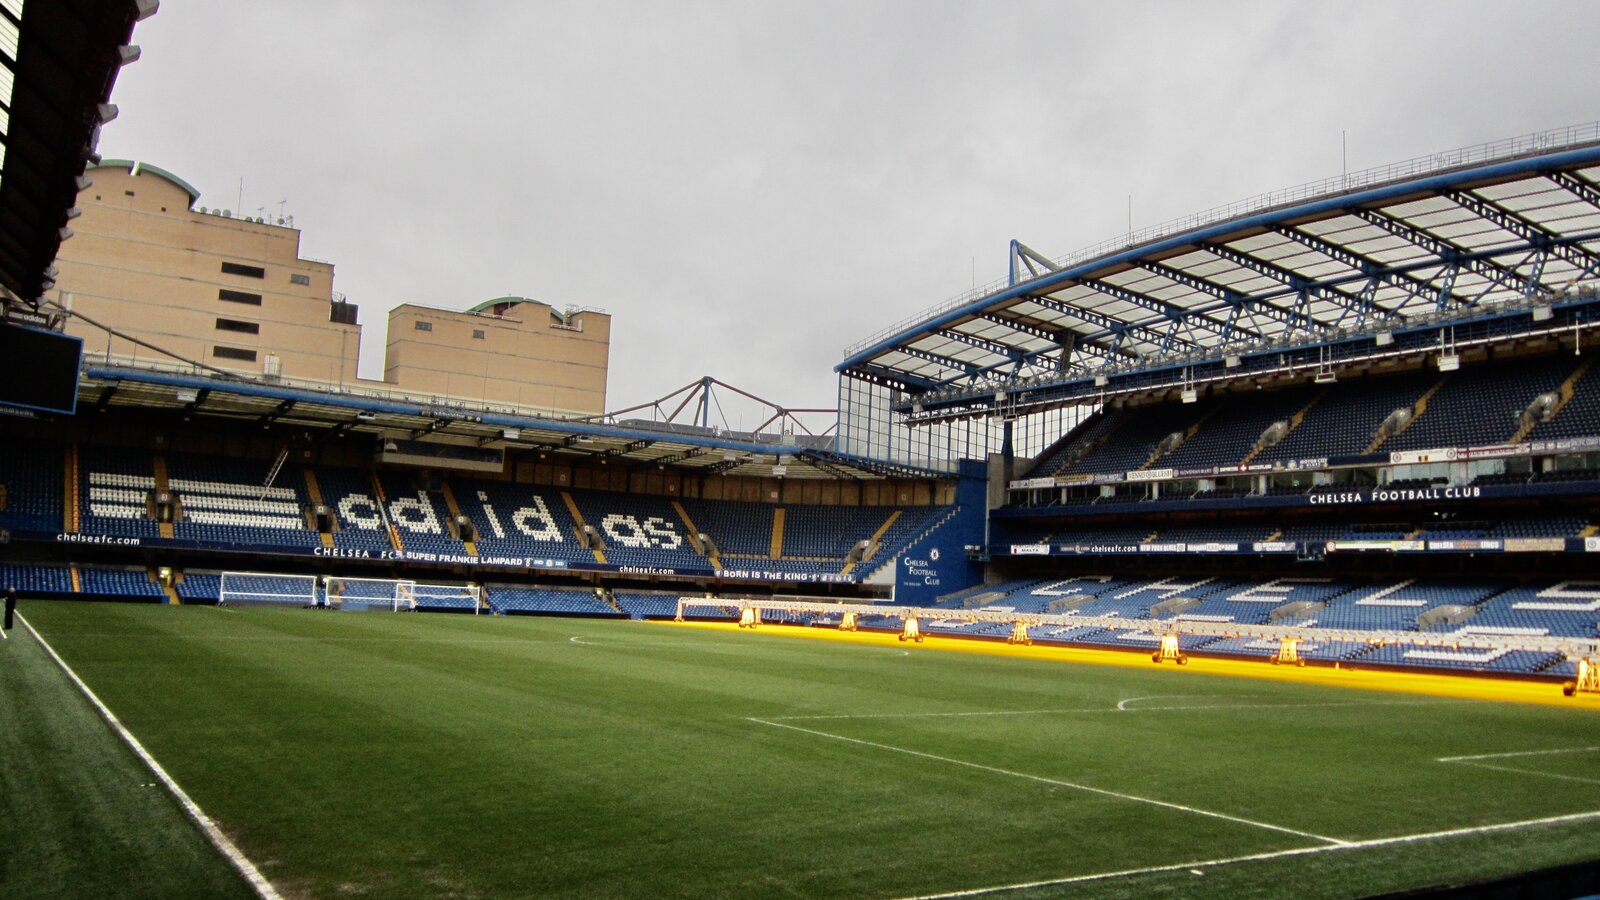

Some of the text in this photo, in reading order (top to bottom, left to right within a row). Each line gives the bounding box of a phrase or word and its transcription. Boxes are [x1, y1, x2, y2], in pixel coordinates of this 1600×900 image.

[1310, 487, 1481, 504] CHELSEA FOOTBALL CLUB
[57, 533, 141, 546] chelseafc.com
[314, 547, 395, 560] CHELSEA FC
[1091, 544, 1137, 553] chelseafc.com
[406, 551, 437, 562] SUPER
[439, 554, 479, 564] FRANKIE
[481, 556, 523, 566] LAMPARD
[904, 556, 929, 567] CHELSEA
[619, 565, 674, 575] chelseafc.com
[723, 570, 808, 581] BORN IS THE KING
[909, 566, 938, 576] FOOTBALL
[925, 576, 942, 586] CLUB
